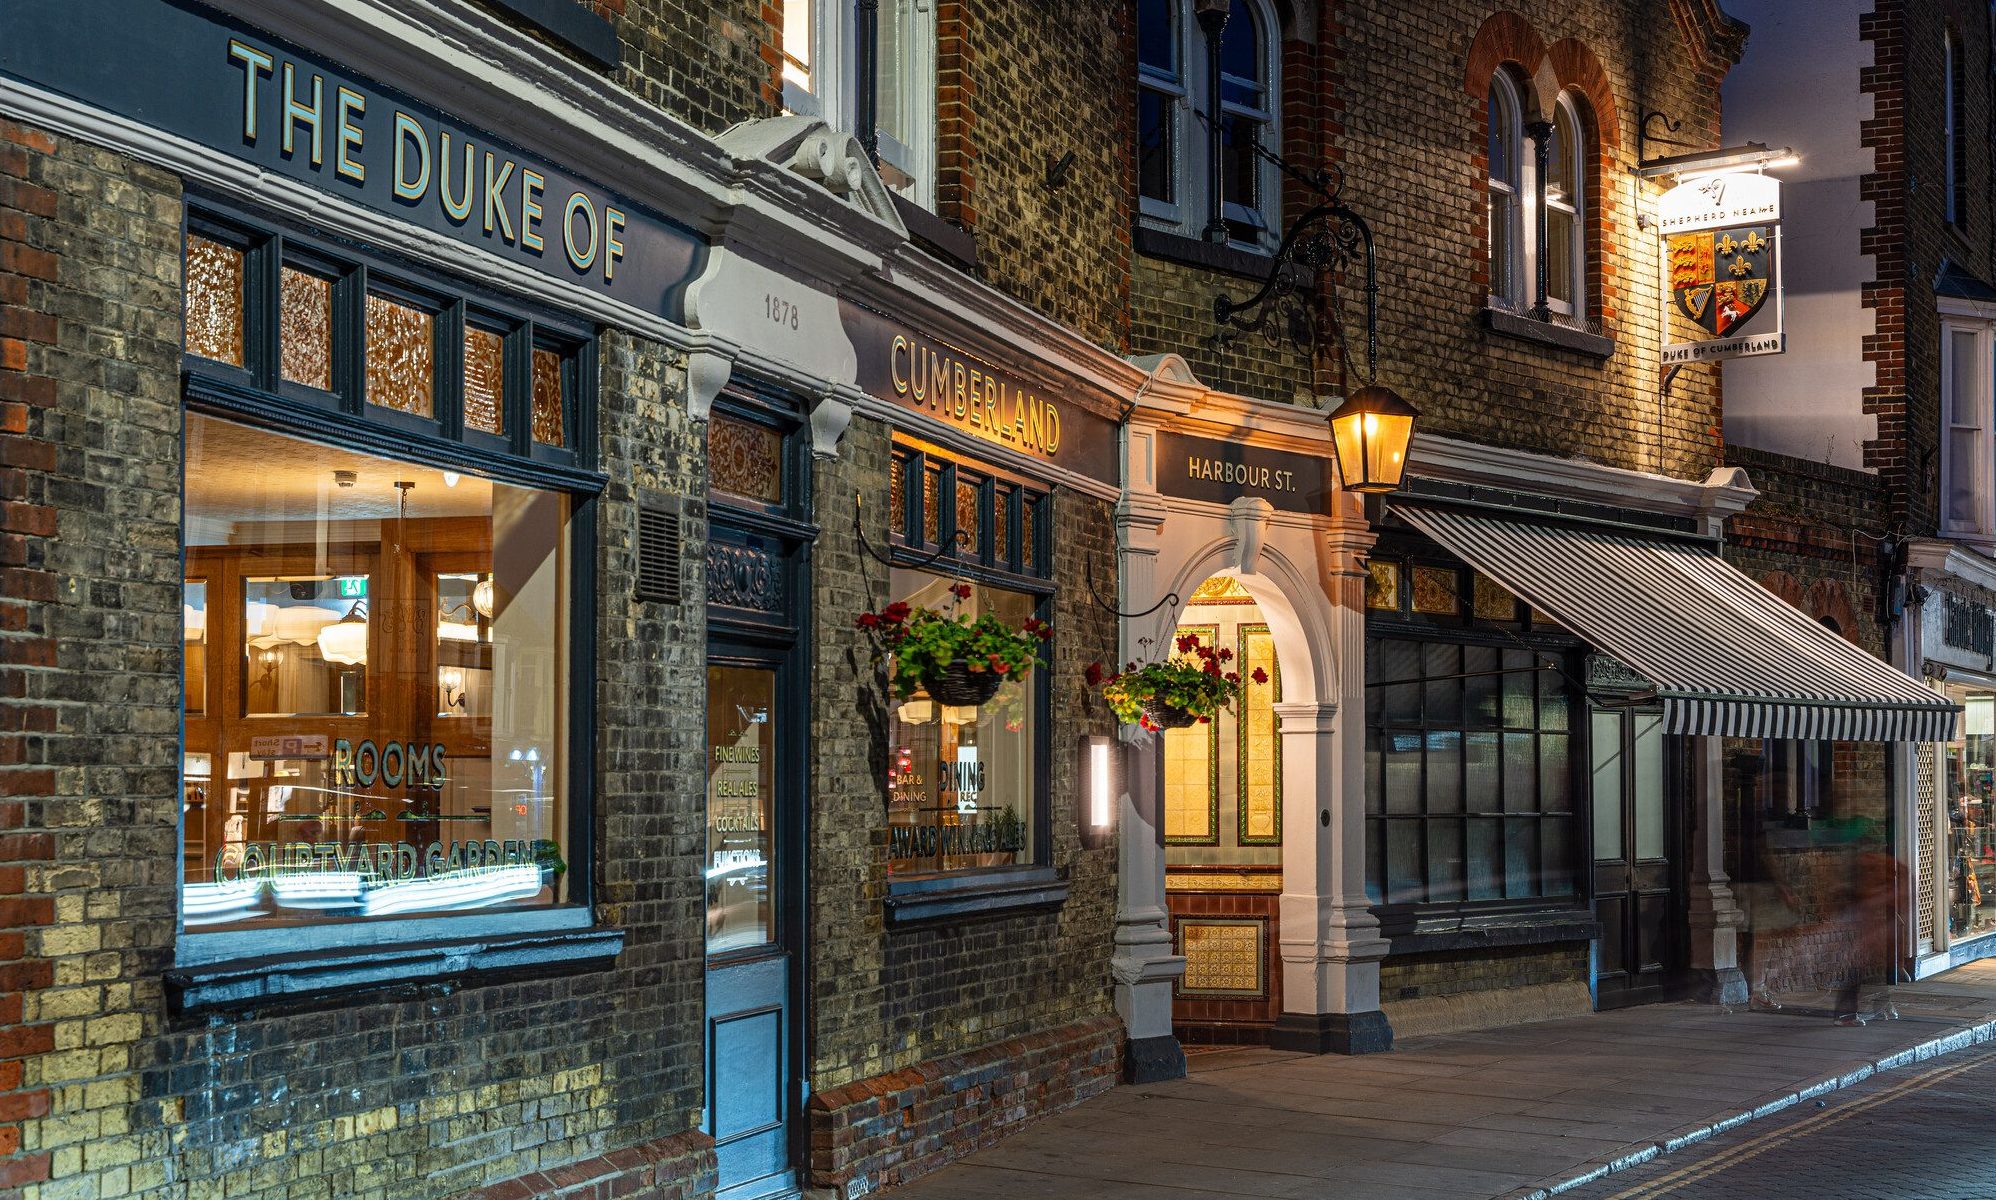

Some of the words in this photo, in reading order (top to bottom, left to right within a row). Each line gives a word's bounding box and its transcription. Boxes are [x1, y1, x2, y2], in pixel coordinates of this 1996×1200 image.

[229, 38, 366, 183] THE
[393, 110, 546, 253] DUKE
[564, 191, 626, 281] OF
[1662, 211, 1726, 227] SHEPHERD
[1733, 204, 1775, 217] NEAME
[765, 293, 799, 331] 1878
[1662, 349, 1689, 362] DUKE
[1693, 346, 1706, 358] OF
[1709, 339, 1779, 354] CUMBERLAND
[891, 335, 1061, 454] CUMBERLAND
[1189, 456, 1271, 489] HARBOUR
[1274, 469, 1297, 493] ST.
[335, 738, 447, 790] ROOMS
[715, 746, 733, 763] FINE
[734, 746, 760, 764] WINES
[717, 780, 737, 798] REAL
[739, 780, 758, 798] ALES
[896, 774, 914, 785] BAR
[916, 774, 923, 785] &
[940, 761, 985, 792] DINING
[893, 791, 927, 803] DINING
[715, 815, 759, 833] COCKTAILS
[888, 825, 938, 859] AWARD
[214, 841, 418, 893] COURTYARD
[424, 839, 536, 883] GARDEN
[713, 850, 760, 870] FUNCTIONS
